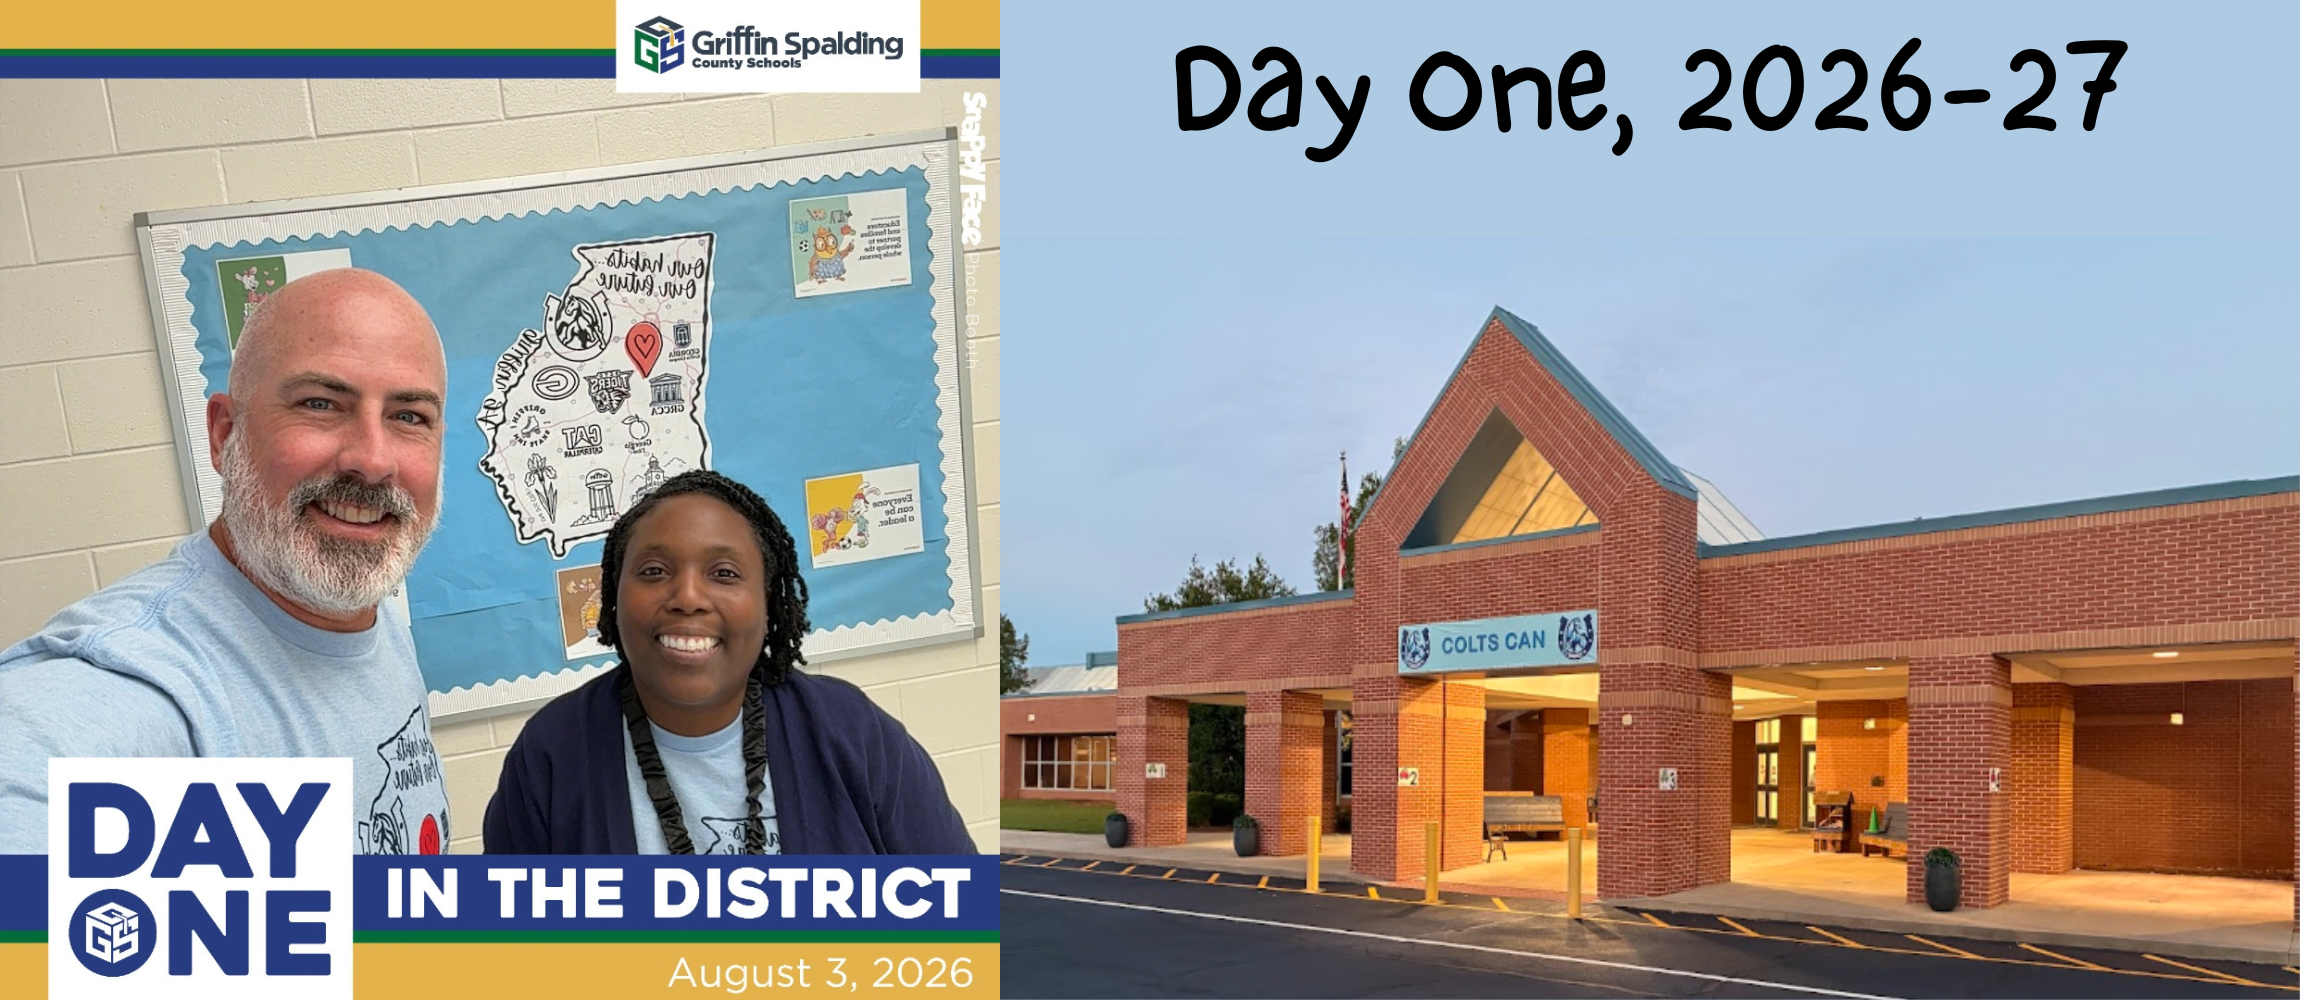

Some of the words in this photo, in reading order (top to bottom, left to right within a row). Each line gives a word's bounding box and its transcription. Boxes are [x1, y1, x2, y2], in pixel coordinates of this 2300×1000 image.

[1442, 634, 1499, 654] COLTS
[1505, 630, 1545, 650] CAN
[1410, 770, 1418, 785] 2
